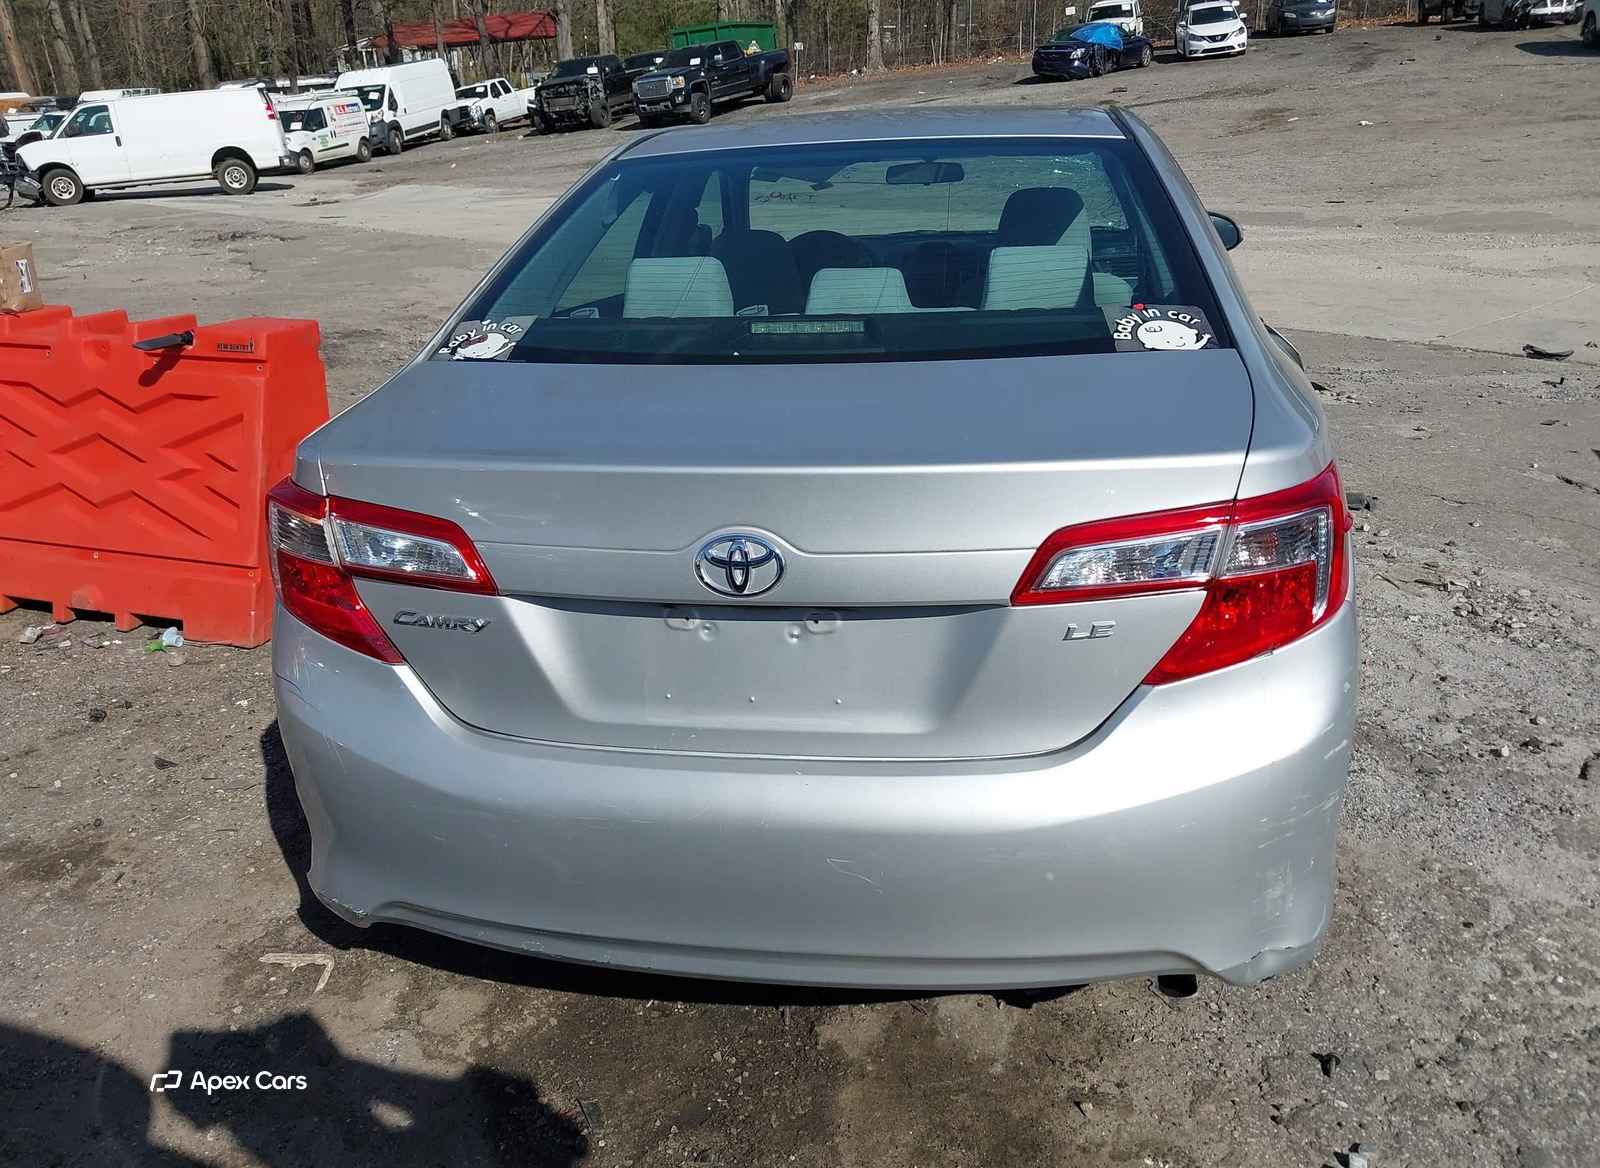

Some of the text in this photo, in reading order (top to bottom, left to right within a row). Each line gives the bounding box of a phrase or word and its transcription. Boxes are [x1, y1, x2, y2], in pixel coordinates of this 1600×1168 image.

[438, 321, 524, 354] Baby in car
[1113, 308, 1201, 340] Baby in car
[393, 609, 493, 635] CAMRY
[1062, 620, 1116, 641] LE
